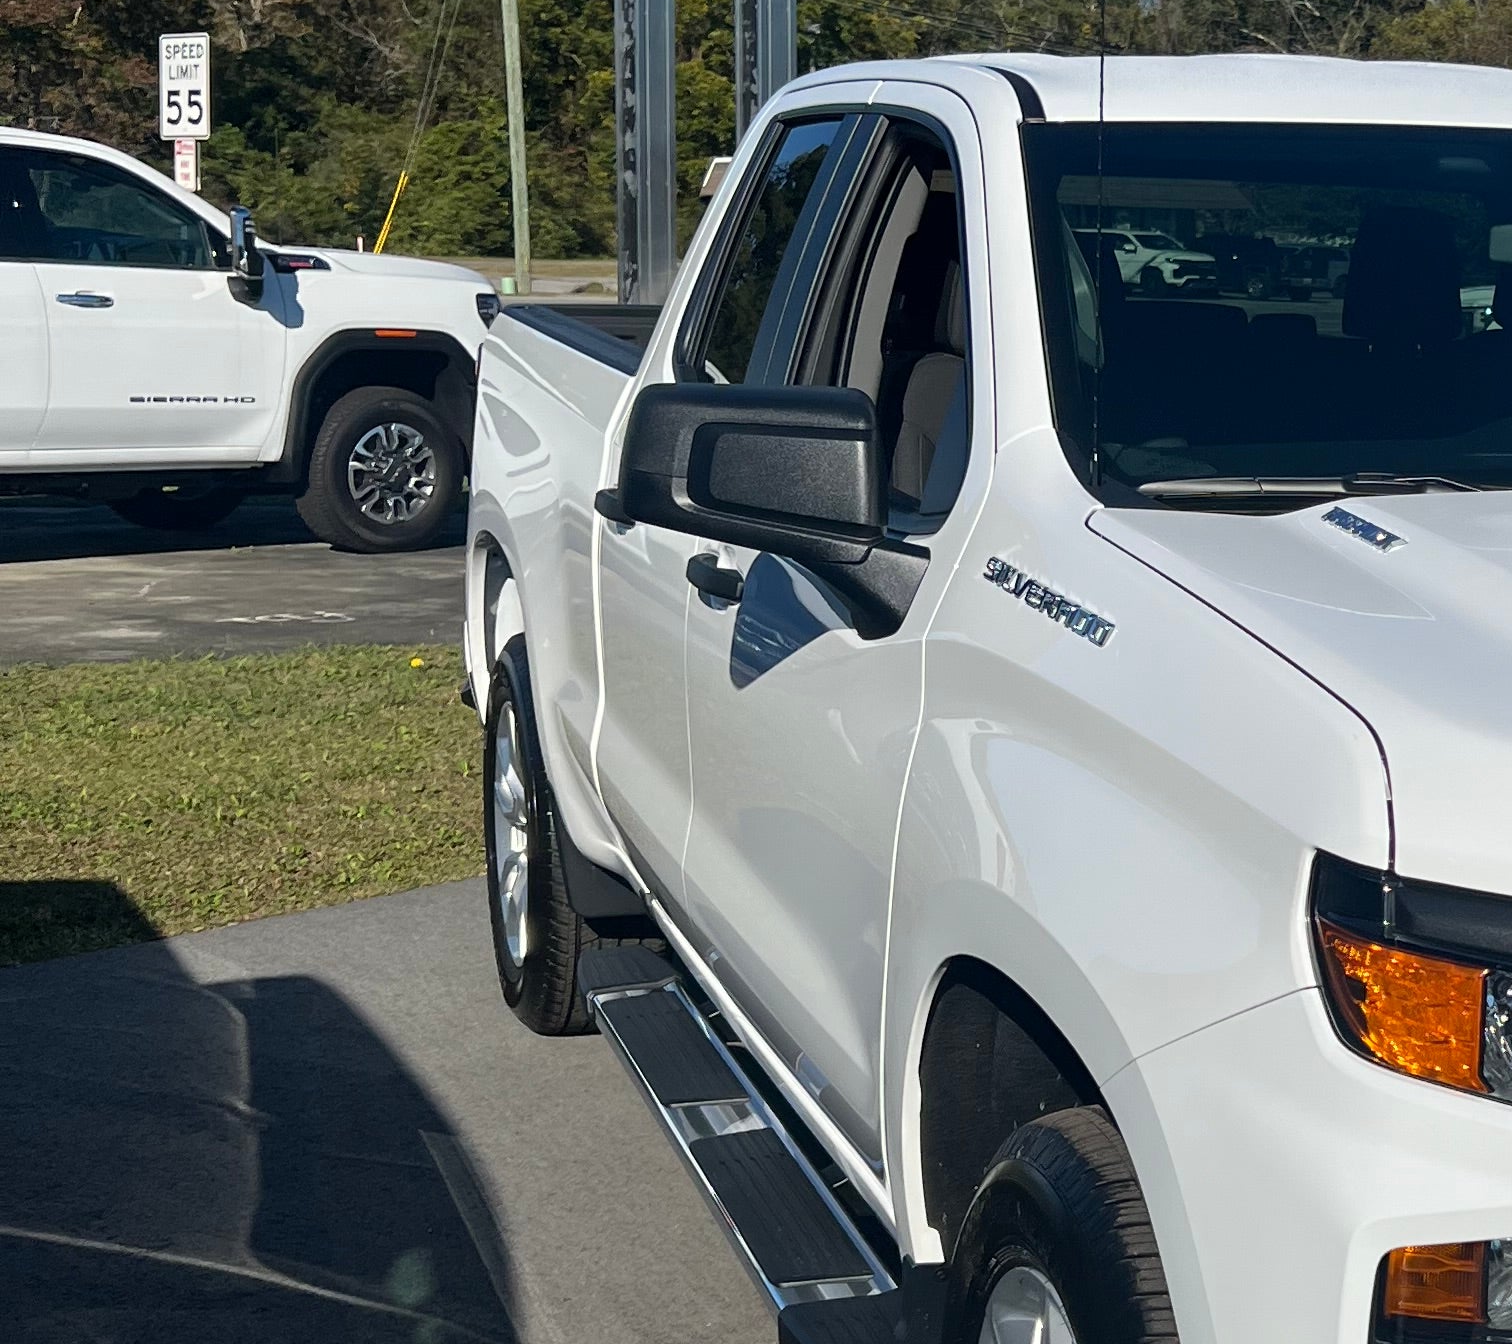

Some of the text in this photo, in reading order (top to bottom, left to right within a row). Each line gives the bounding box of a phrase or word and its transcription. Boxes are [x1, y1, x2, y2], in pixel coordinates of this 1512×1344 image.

[165, 42, 204, 60] SPEED
[168, 64, 200, 80] LIMIT
[167, 90, 203, 125] 55
[982, 556, 1116, 647] SILVERADO
